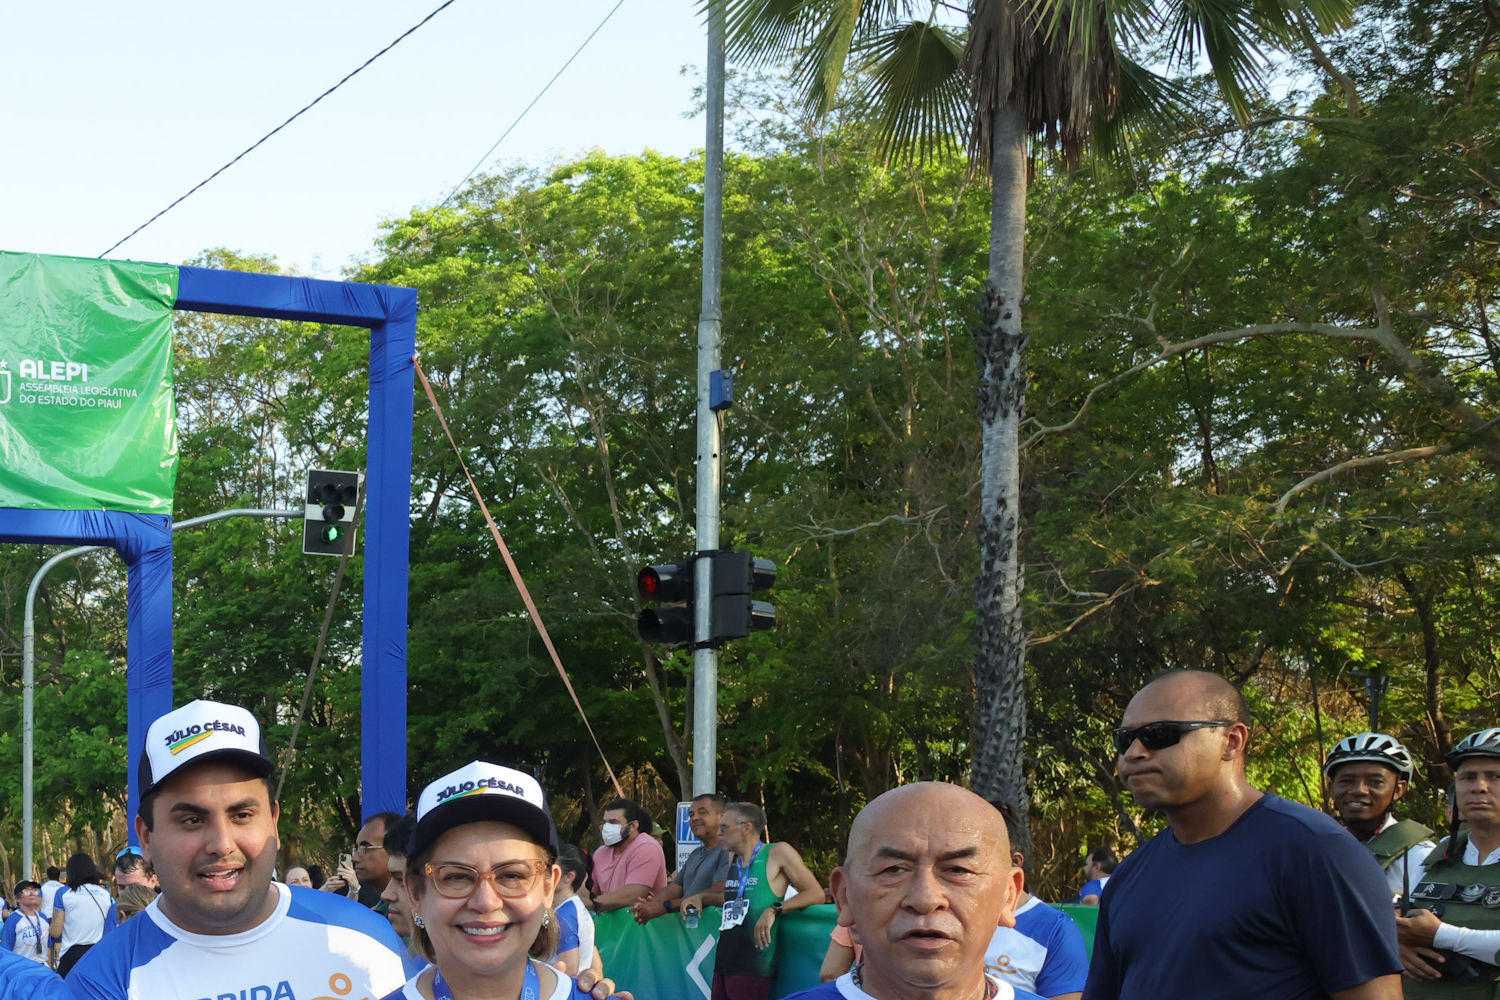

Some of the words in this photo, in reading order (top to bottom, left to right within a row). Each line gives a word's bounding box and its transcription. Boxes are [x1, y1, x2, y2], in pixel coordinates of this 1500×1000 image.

[19, 358, 88, 382] ALEPI
[19, 382, 79, 395] ASSEMBLEIA
[80, 386, 138, 398] LEGISLATIVA
[19, 394, 36, 404] DO
[37, 395, 78, 406] ESTADO
[79, 397, 96, 407] DO
[164, 723, 201, 746] JÚLIO
[203, 719, 246, 737] CÉSAR
[436, 780, 475, 802] JÚLIO
[476, 777, 525, 798] CÉSAR
